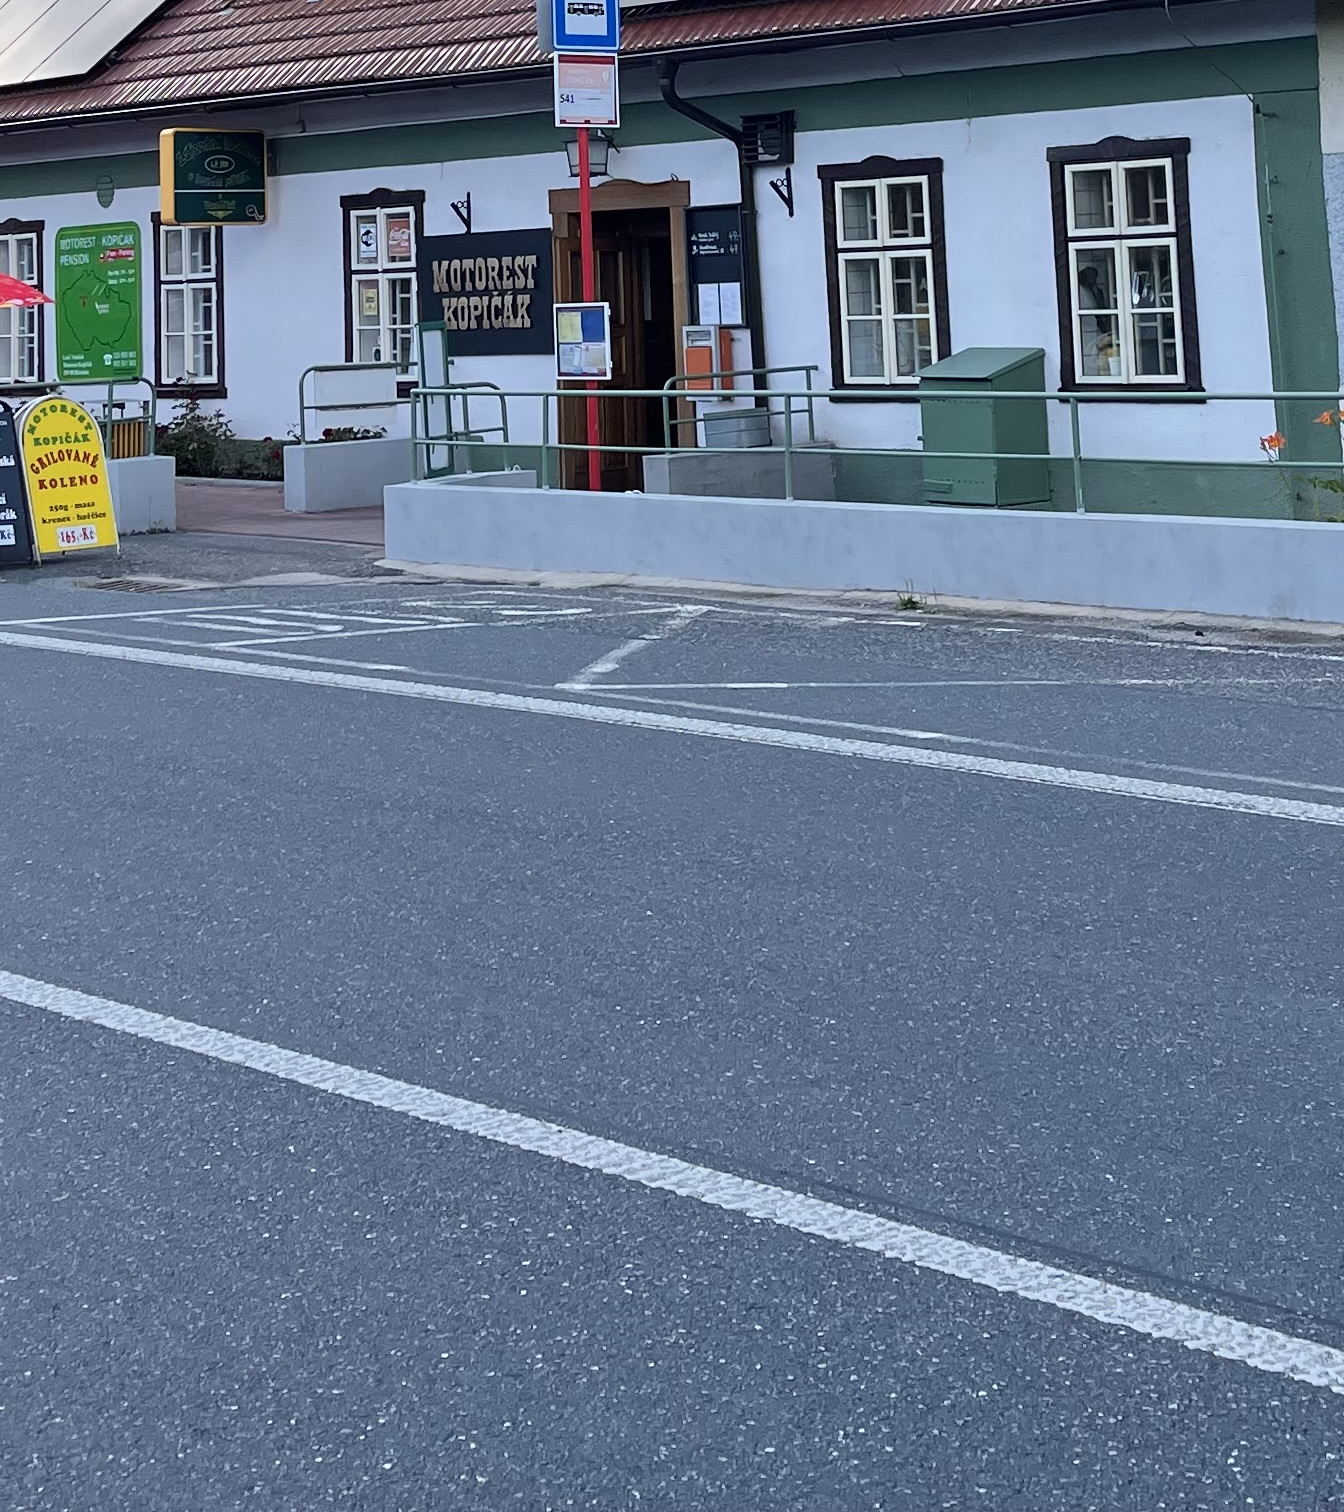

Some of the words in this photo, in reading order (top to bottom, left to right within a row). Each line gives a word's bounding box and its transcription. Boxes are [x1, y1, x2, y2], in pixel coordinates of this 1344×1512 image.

[559, 93, 575, 104] 541
[60, 236, 97, 251] MOTOREST
[60, 253, 90, 267] PENSION
[432, 254, 538, 294] MOTOREST
[442, 291, 532, 331] KOPIČÁK
[27, 403, 93, 436] MOTOREST
[33, 432, 91, 447] KOPIČÁK
[29, 448, 100, 475] GRILOVANÉ
[38, 474, 99, 491] KOLENO
